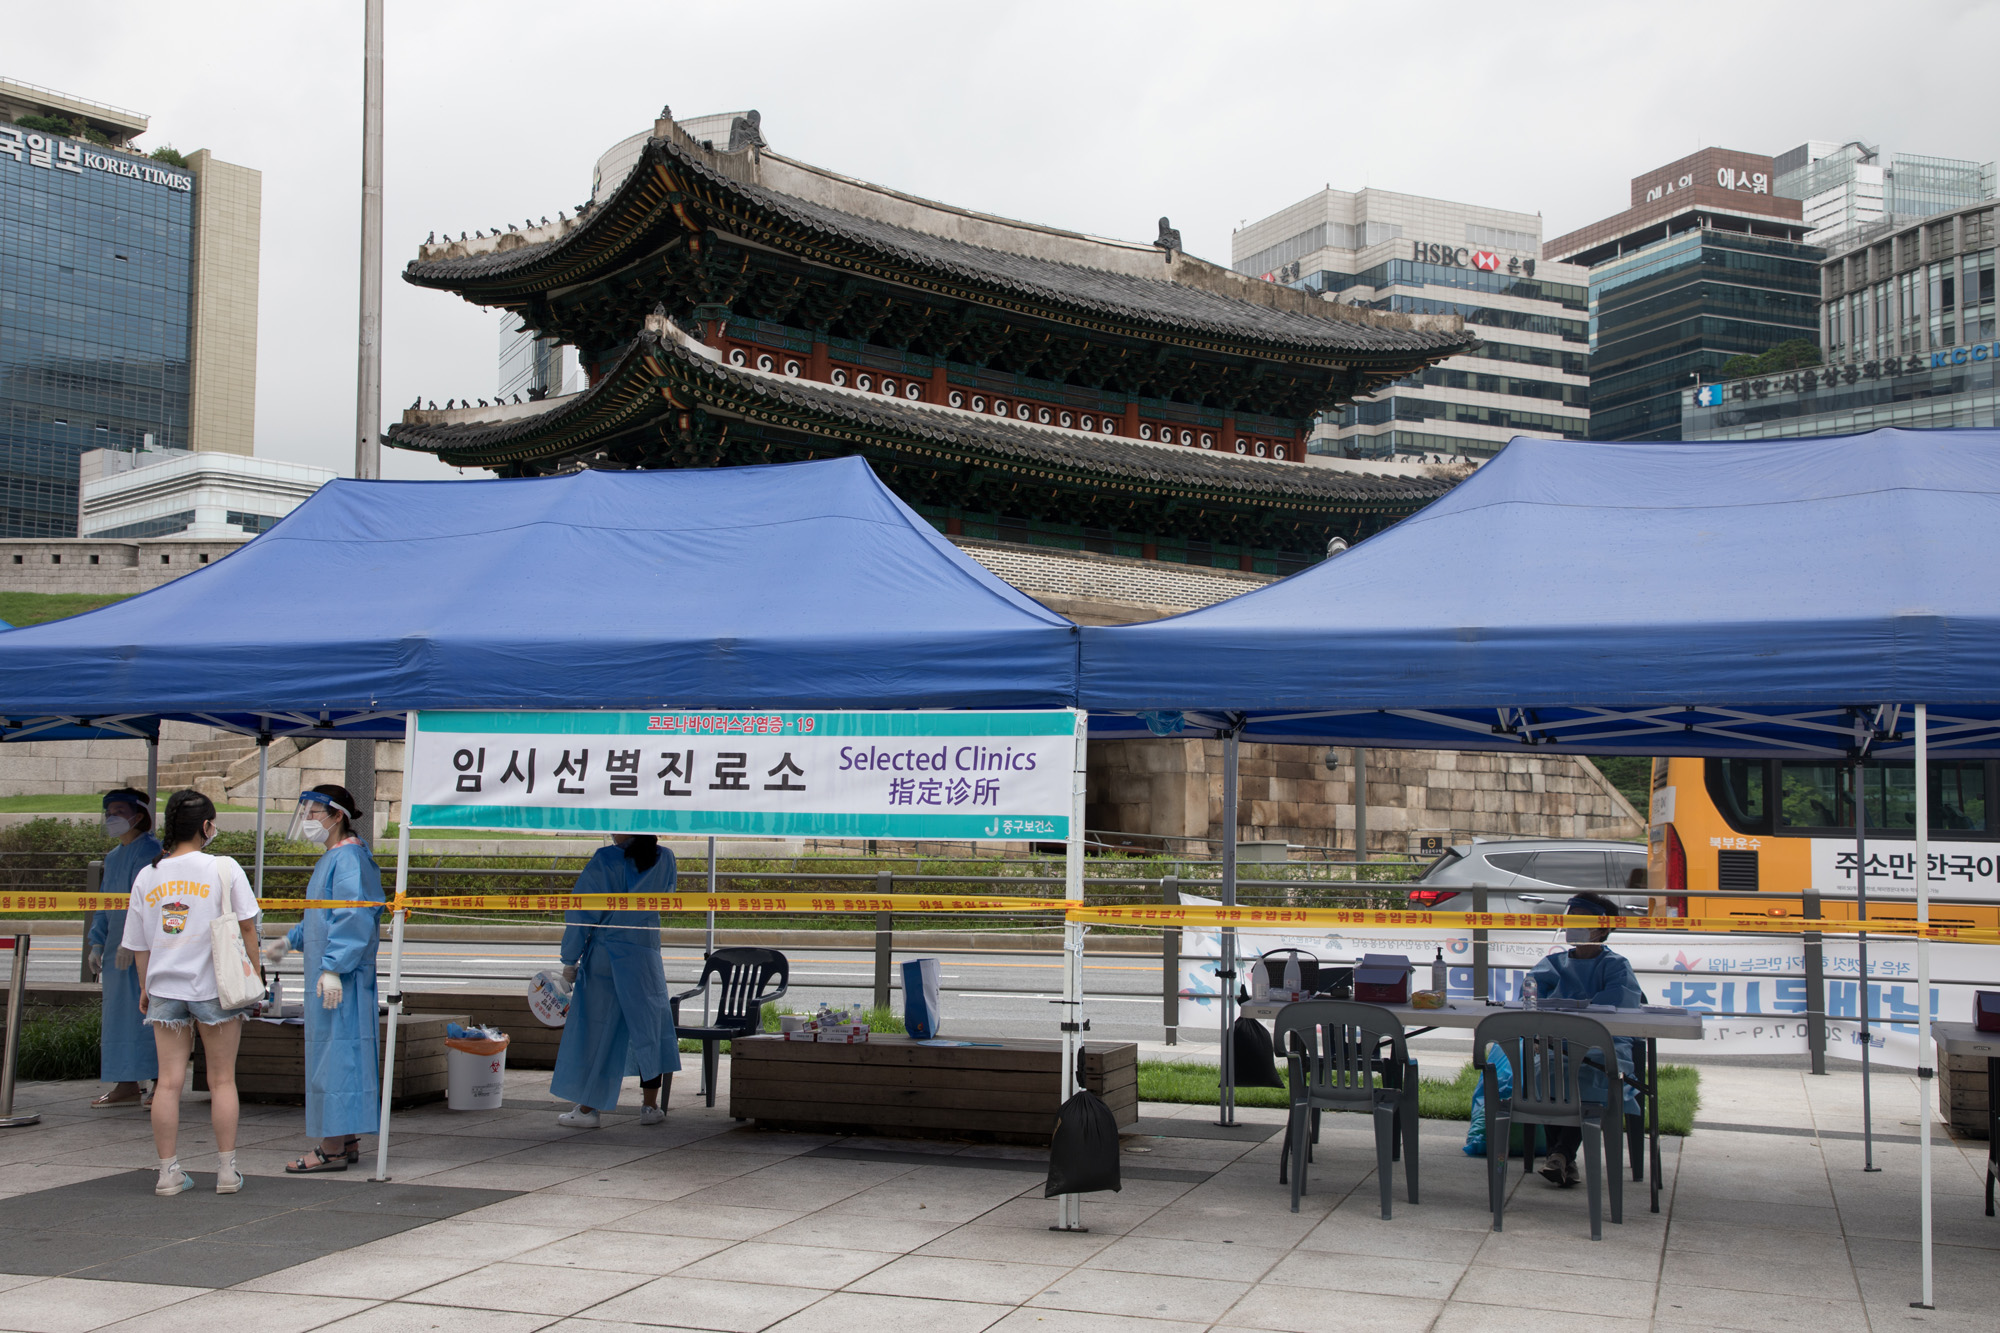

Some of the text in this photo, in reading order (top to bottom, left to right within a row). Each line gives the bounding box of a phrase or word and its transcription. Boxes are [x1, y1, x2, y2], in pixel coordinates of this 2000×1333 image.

[83, 152, 192, 191] KOREA TIMES
[1413, 241, 1469, 267] HSBC
[1930, 341, 2000, 369] KCCI
[646, 715, 783, 734] 코로나바이러스감염증
[796, 717, 815, 733] 19
[839, 745, 1037, 771] Selected Clinics
[453, 747, 807, 797] 임시선별진료소
[888, 777, 1001, 806] 指定诊所
[1002, 820, 1055, 835] 중구보건소
[1709, 836, 1761, 850] 북부운수
[1835, 852, 1917, 880] 주소만
[17, 896, 57, 909] 출입금지
[78, 897, 97, 910] 위험
[145, 880, 210, 908] STUFFING
[507, 896, 529, 909] 위험
[537, 896, 582, 910] 출입금지
[606, 896, 629, 910] 위험
[636, 897, 683, 910] 출입금지
[708, 898, 730, 911] 위험
[738, 898, 787, 911] 출입금지
[811, 899, 835, 911] 위험
[843, 899, 893, 911] 출입금지
[1465, 913, 1493, 925] 위험
[1503, 914, 1565, 927] 출입금지
